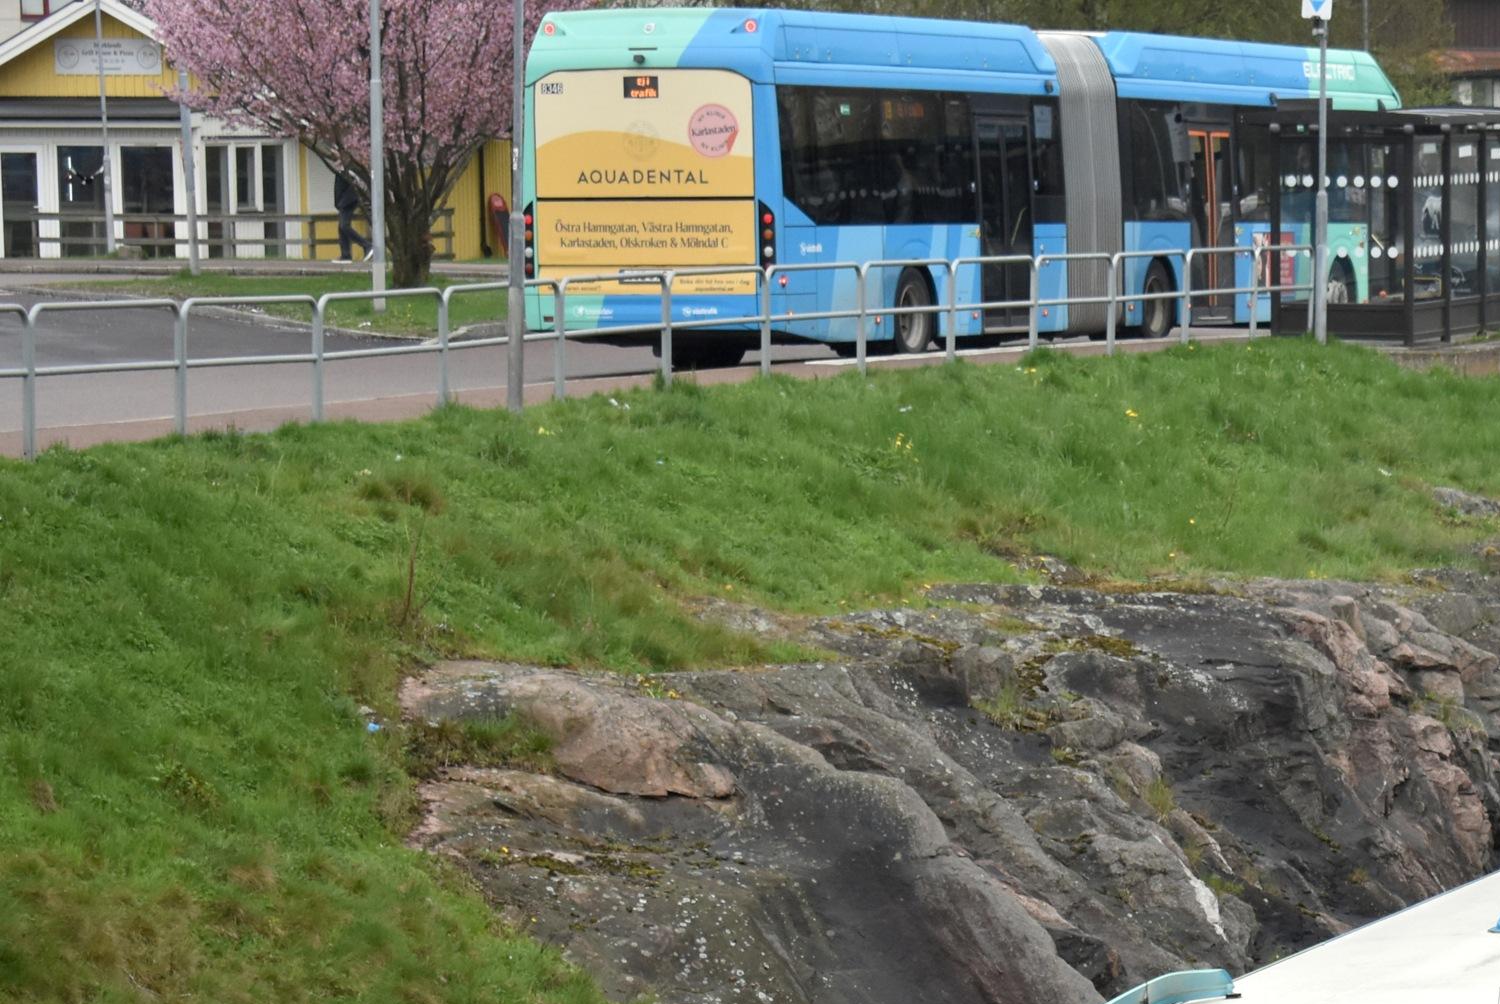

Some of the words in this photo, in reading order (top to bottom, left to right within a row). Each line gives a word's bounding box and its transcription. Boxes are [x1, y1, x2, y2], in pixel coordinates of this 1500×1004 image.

[630, 88, 657, 98] trafik
[691, 125, 736, 137] Karlastaden
[577, 170, 709, 184] AQUADENTAL
[555, 219, 580, 233] Östra
[583, 221, 639, 235] Hamngatan,
[642, 221, 673, 233] Västra
[675, 221, 734, 235] Hamngatan,
[560, 237, 618, 250] Karlastaden,
[620, 237, 668, 248] Olskroken
[670, 237, 678, 248] &
[680, 236, 719, 248] Mölndal
[721, 237, 729, 248] C
